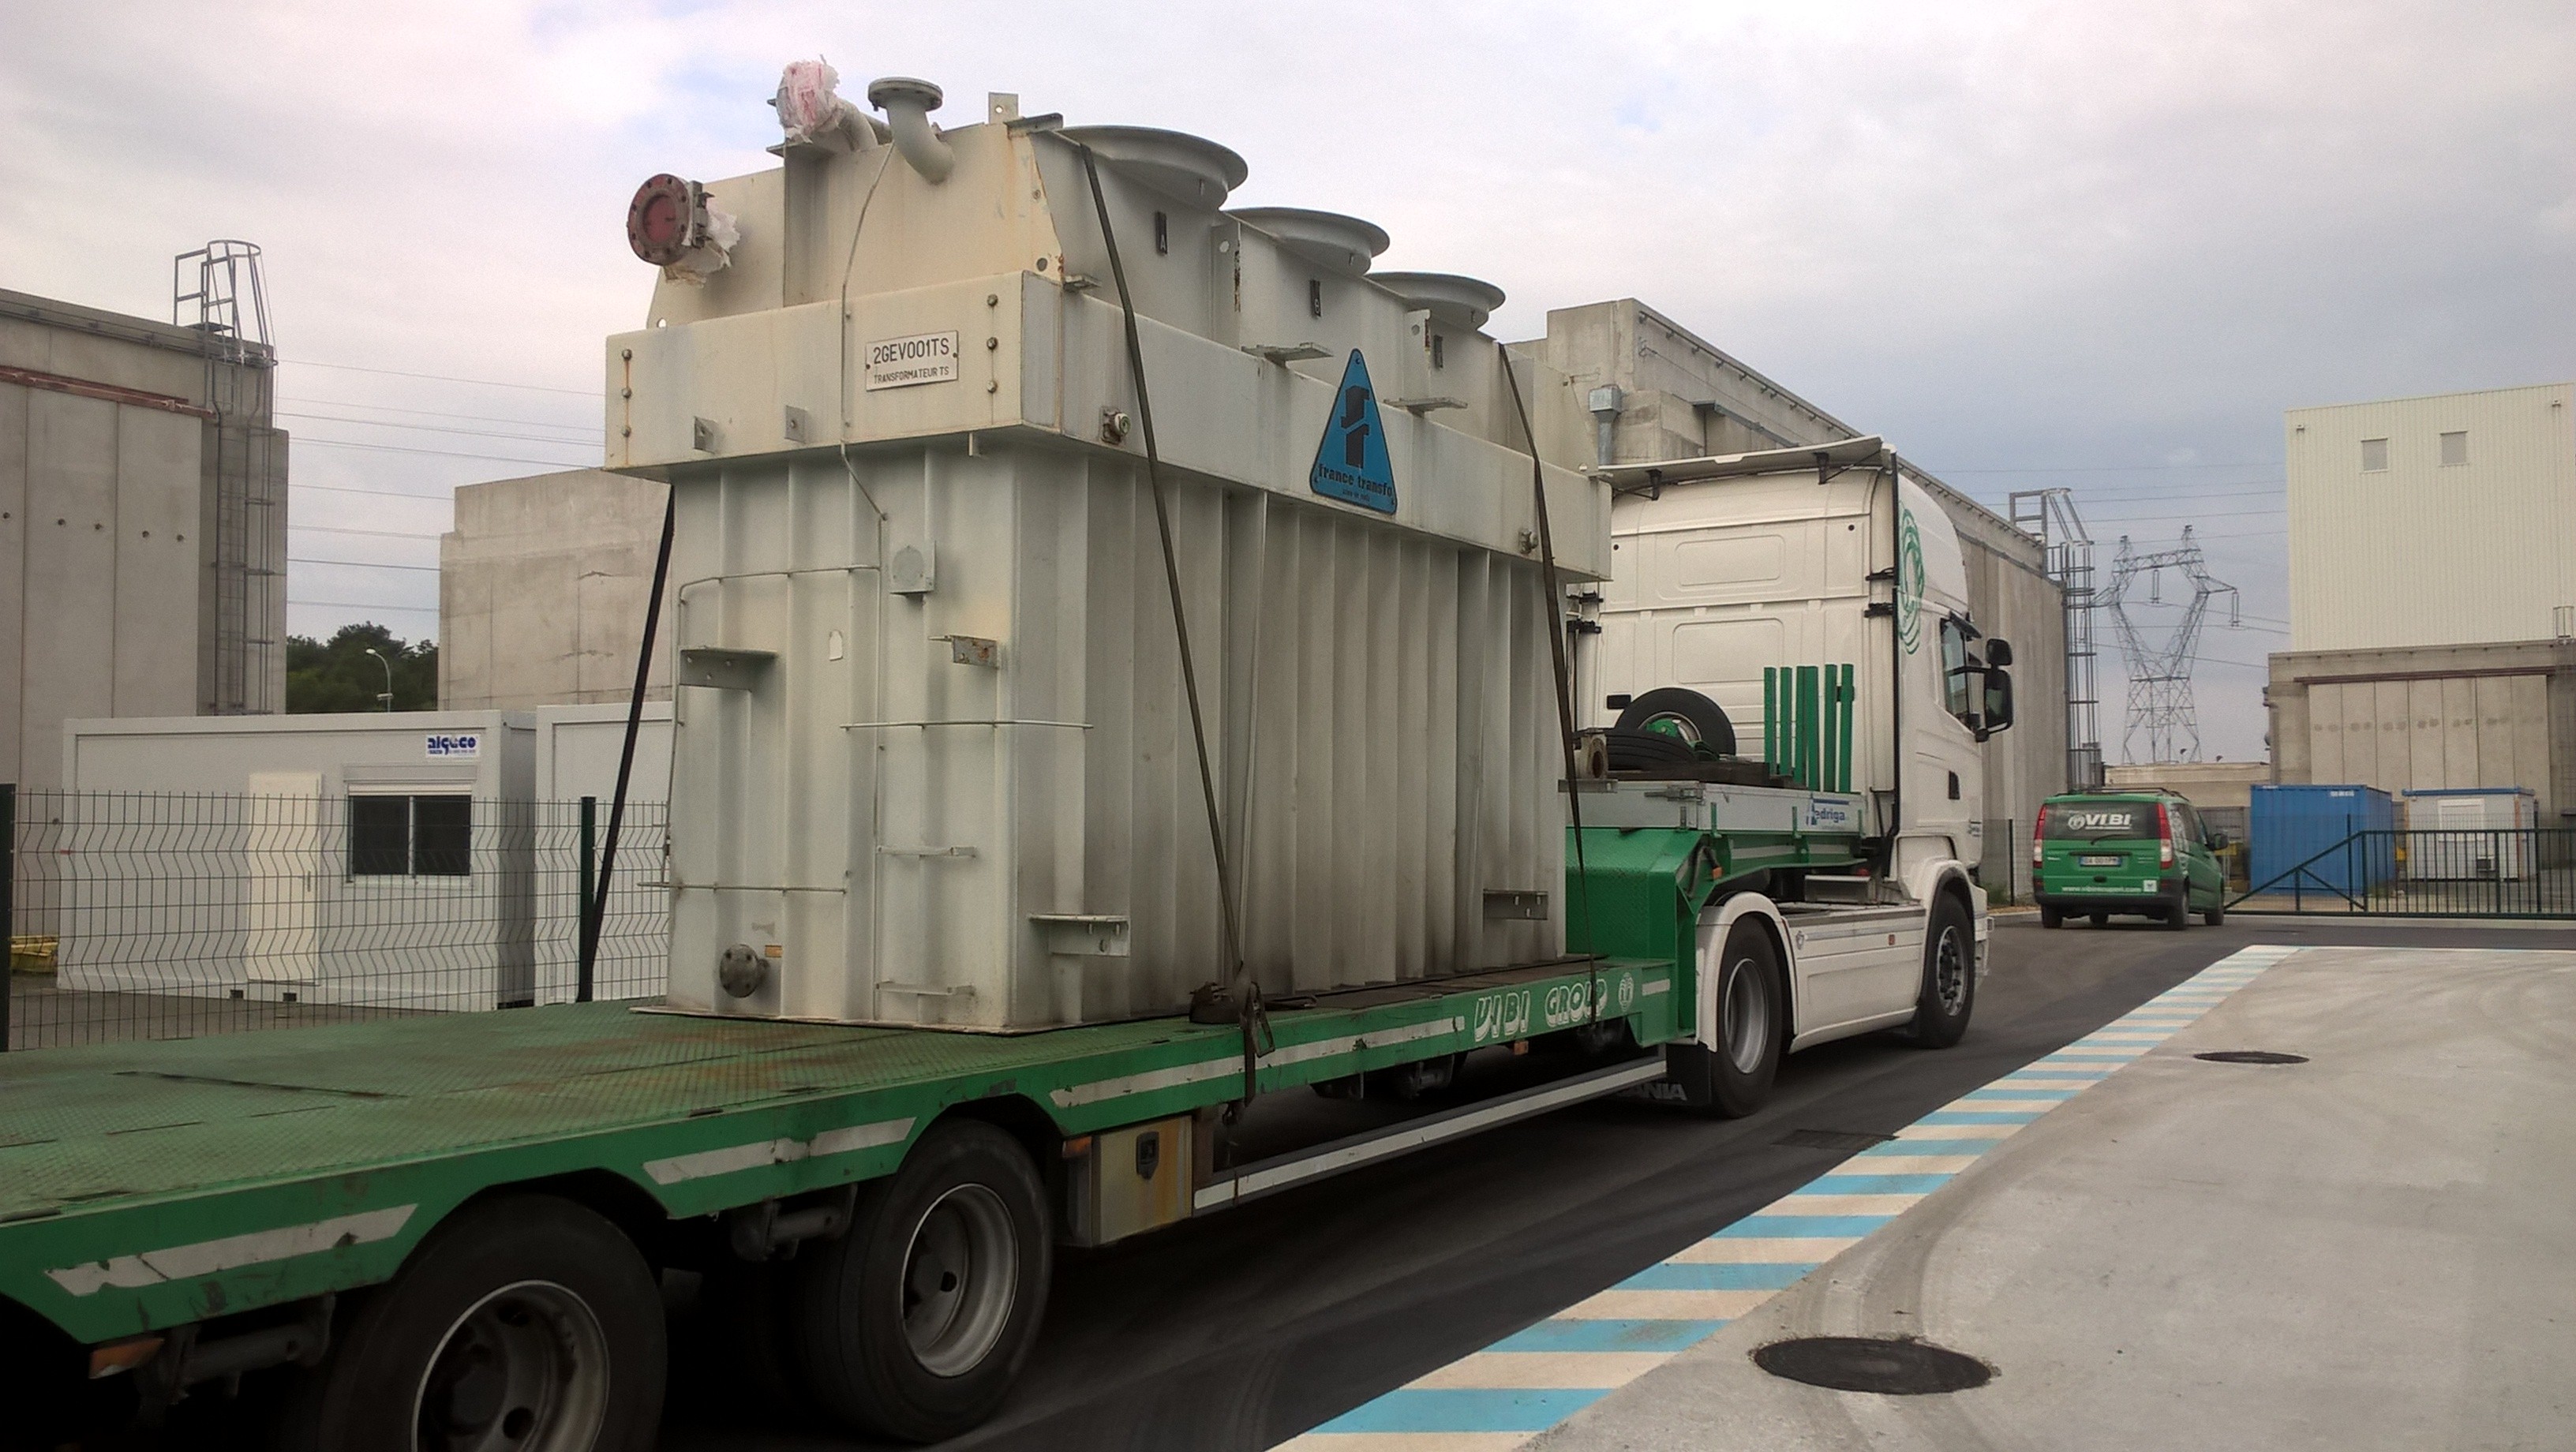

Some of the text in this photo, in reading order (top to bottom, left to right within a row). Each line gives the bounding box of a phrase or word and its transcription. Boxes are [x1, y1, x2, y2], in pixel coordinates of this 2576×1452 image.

[874, 366, 949, 384] TRANSFORMATEUR TS
[1319, 463, 1354, 485] france
[1357, 475, 1393, 497] transfo
[1544, 979, 1608, 1028] GROUP
